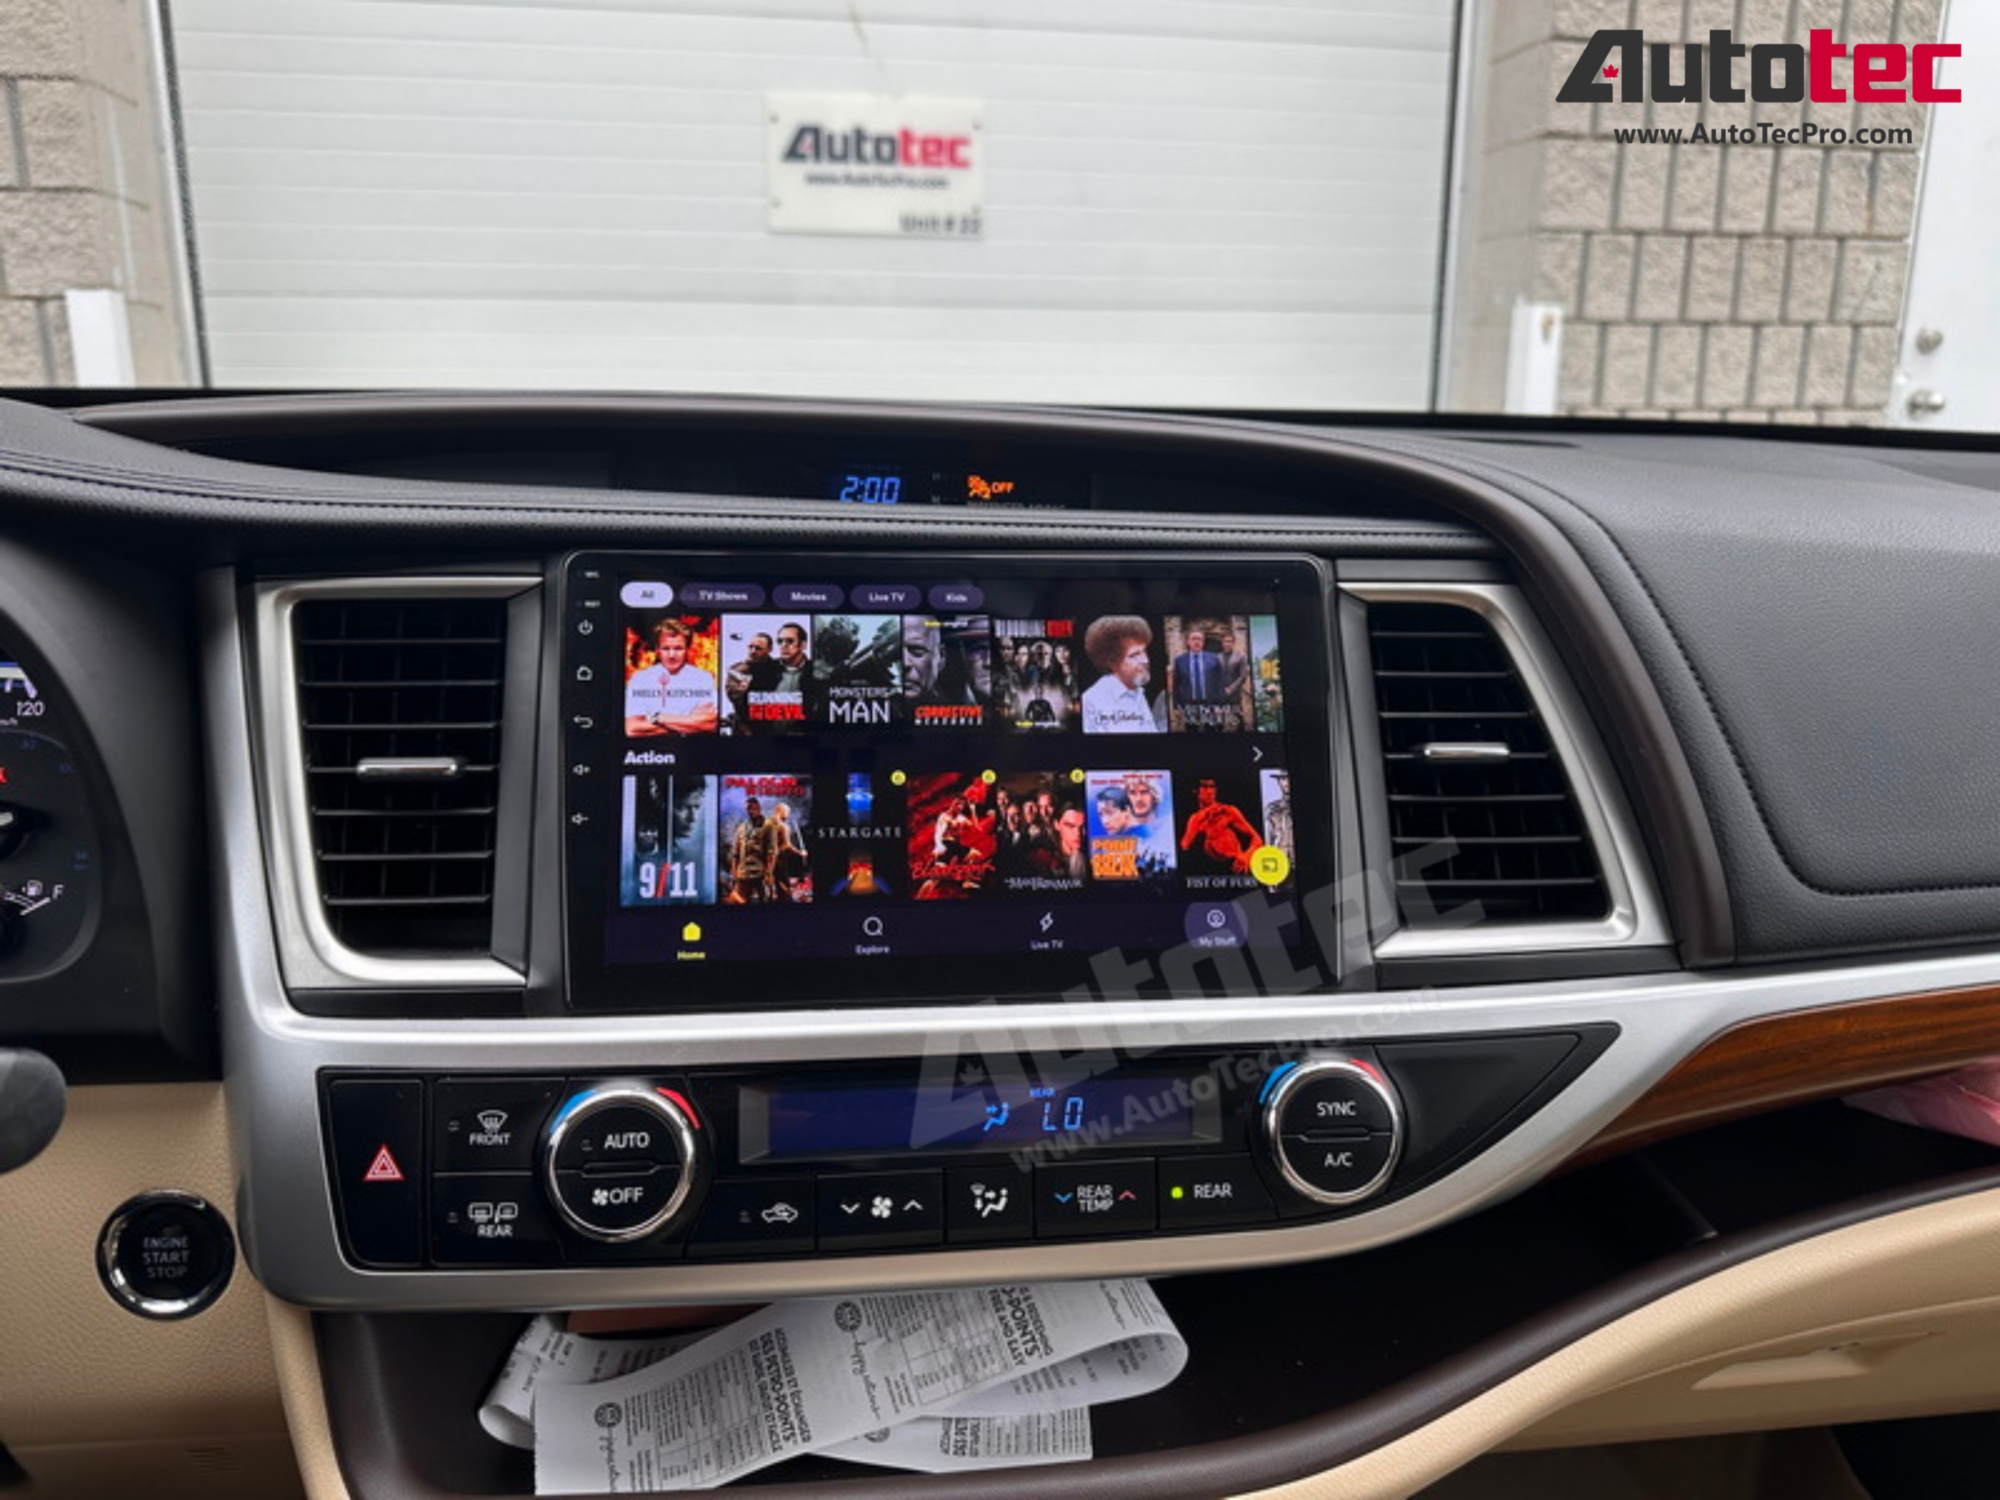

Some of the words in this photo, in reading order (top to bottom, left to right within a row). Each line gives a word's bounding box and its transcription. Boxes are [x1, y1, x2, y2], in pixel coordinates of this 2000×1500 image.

[782, 123, 972, 168] Autotec
[840, 476, 900, 504] 2:00
[992, 482, 1014, 494] OFF
[699, 590, 712, 600] TV
[714, 590, 749, 601] Shows
[791, 591, 827, 602] Movies
[868, 592, 888, 601] Live
[890, 592, 906, 602] TV
[17, 701, 45, 716] 120
[829, 701, 891, 723] MAN
[624, 751, 676, 765] Action
[818, 827, 901, 838] STARGATE
[638, 862, 698, 898] 9/11
[52, 884, 64, 899] F
[855, 945, 890, 955] Explore
[1031, 940, 1048, 949] Live
[1050, 939, 1064, 949] TV
[677, 950, 705, 960] Home
[1316, 1102, 1356, 1117] SYNC
[469, 1133, 511, 1145] FRONT
[604, 1132, 650, 1149] AUTO
[1324, 1153, 1353, 1168] A/C
[609, 1187, 644, 1203] OFF
[1077, 1185, 1113, 1199] REAR
[1193, 1184, 1232, 1199] REAR
[1079, 1199, 1114, 1212] TEMP
[478, 1224, 513, 1237] REAR
[142, 1237, 189, 1248] ENGINE
[142, 1250, 190, 1264] START
[147, 1266, 188, 1278] STOP
